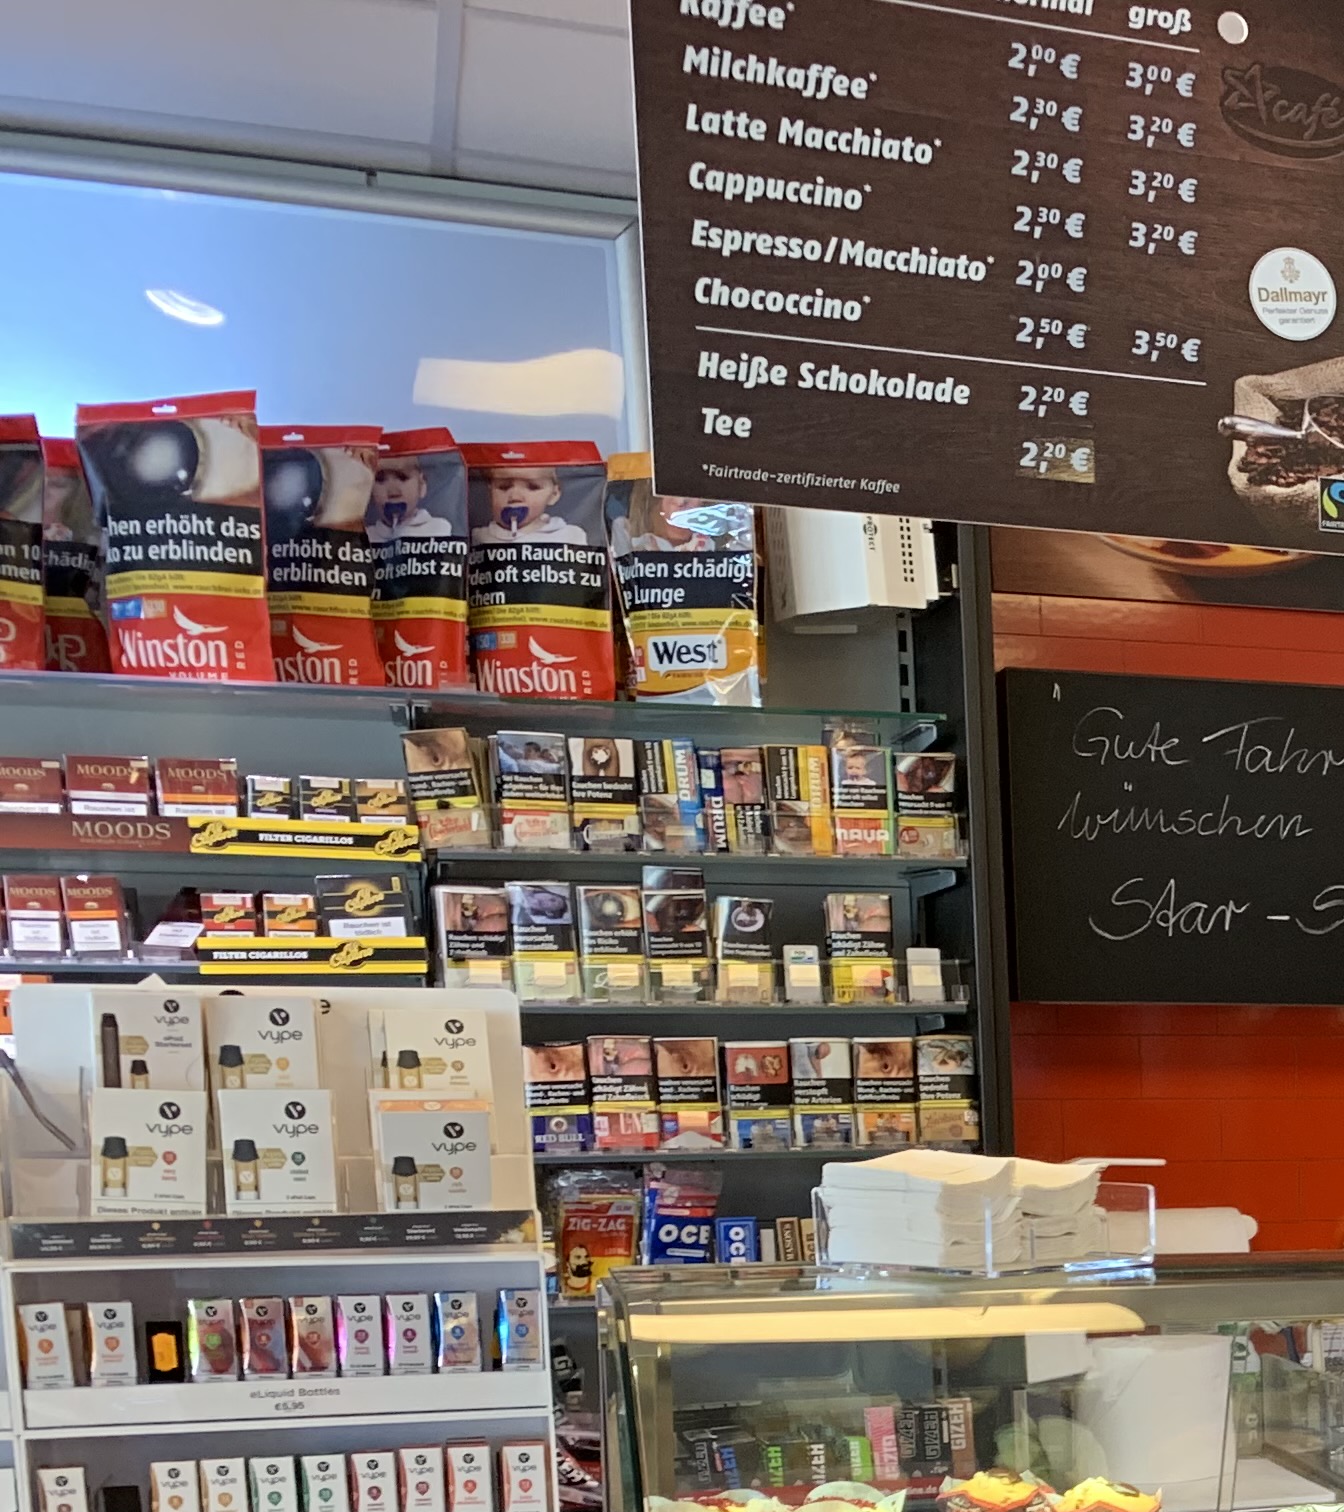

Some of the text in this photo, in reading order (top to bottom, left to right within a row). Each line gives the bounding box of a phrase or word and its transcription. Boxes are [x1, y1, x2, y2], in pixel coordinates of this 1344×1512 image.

[1128, 6, 1193, 34] groß
[685, 103, 767, 141] Latte
[1257, 287, 1329, 306] Dallmayr
[698, 351, 788, 389] Heiße
[798, 363, 970, 405] Schokolade
[701, 407, 752, 438] Tee
[860, 477, 900, 495] Kaffee
[146, 513, 261, 539] erhöht das
[148, 539, 253, 564] erblinden
[272, 538, 332, 560] erhöht
[521, 545, 606, 566] Rauchern
[273, 563, 367, 586] erblinden
[522, 566, 576, 585] selbst
[651, 639, 719, 666] West
[477, 659, 577, 694] Winston
[71, 821, 171, 840] MOODS
[711, 796, 726, 848] DRUM
